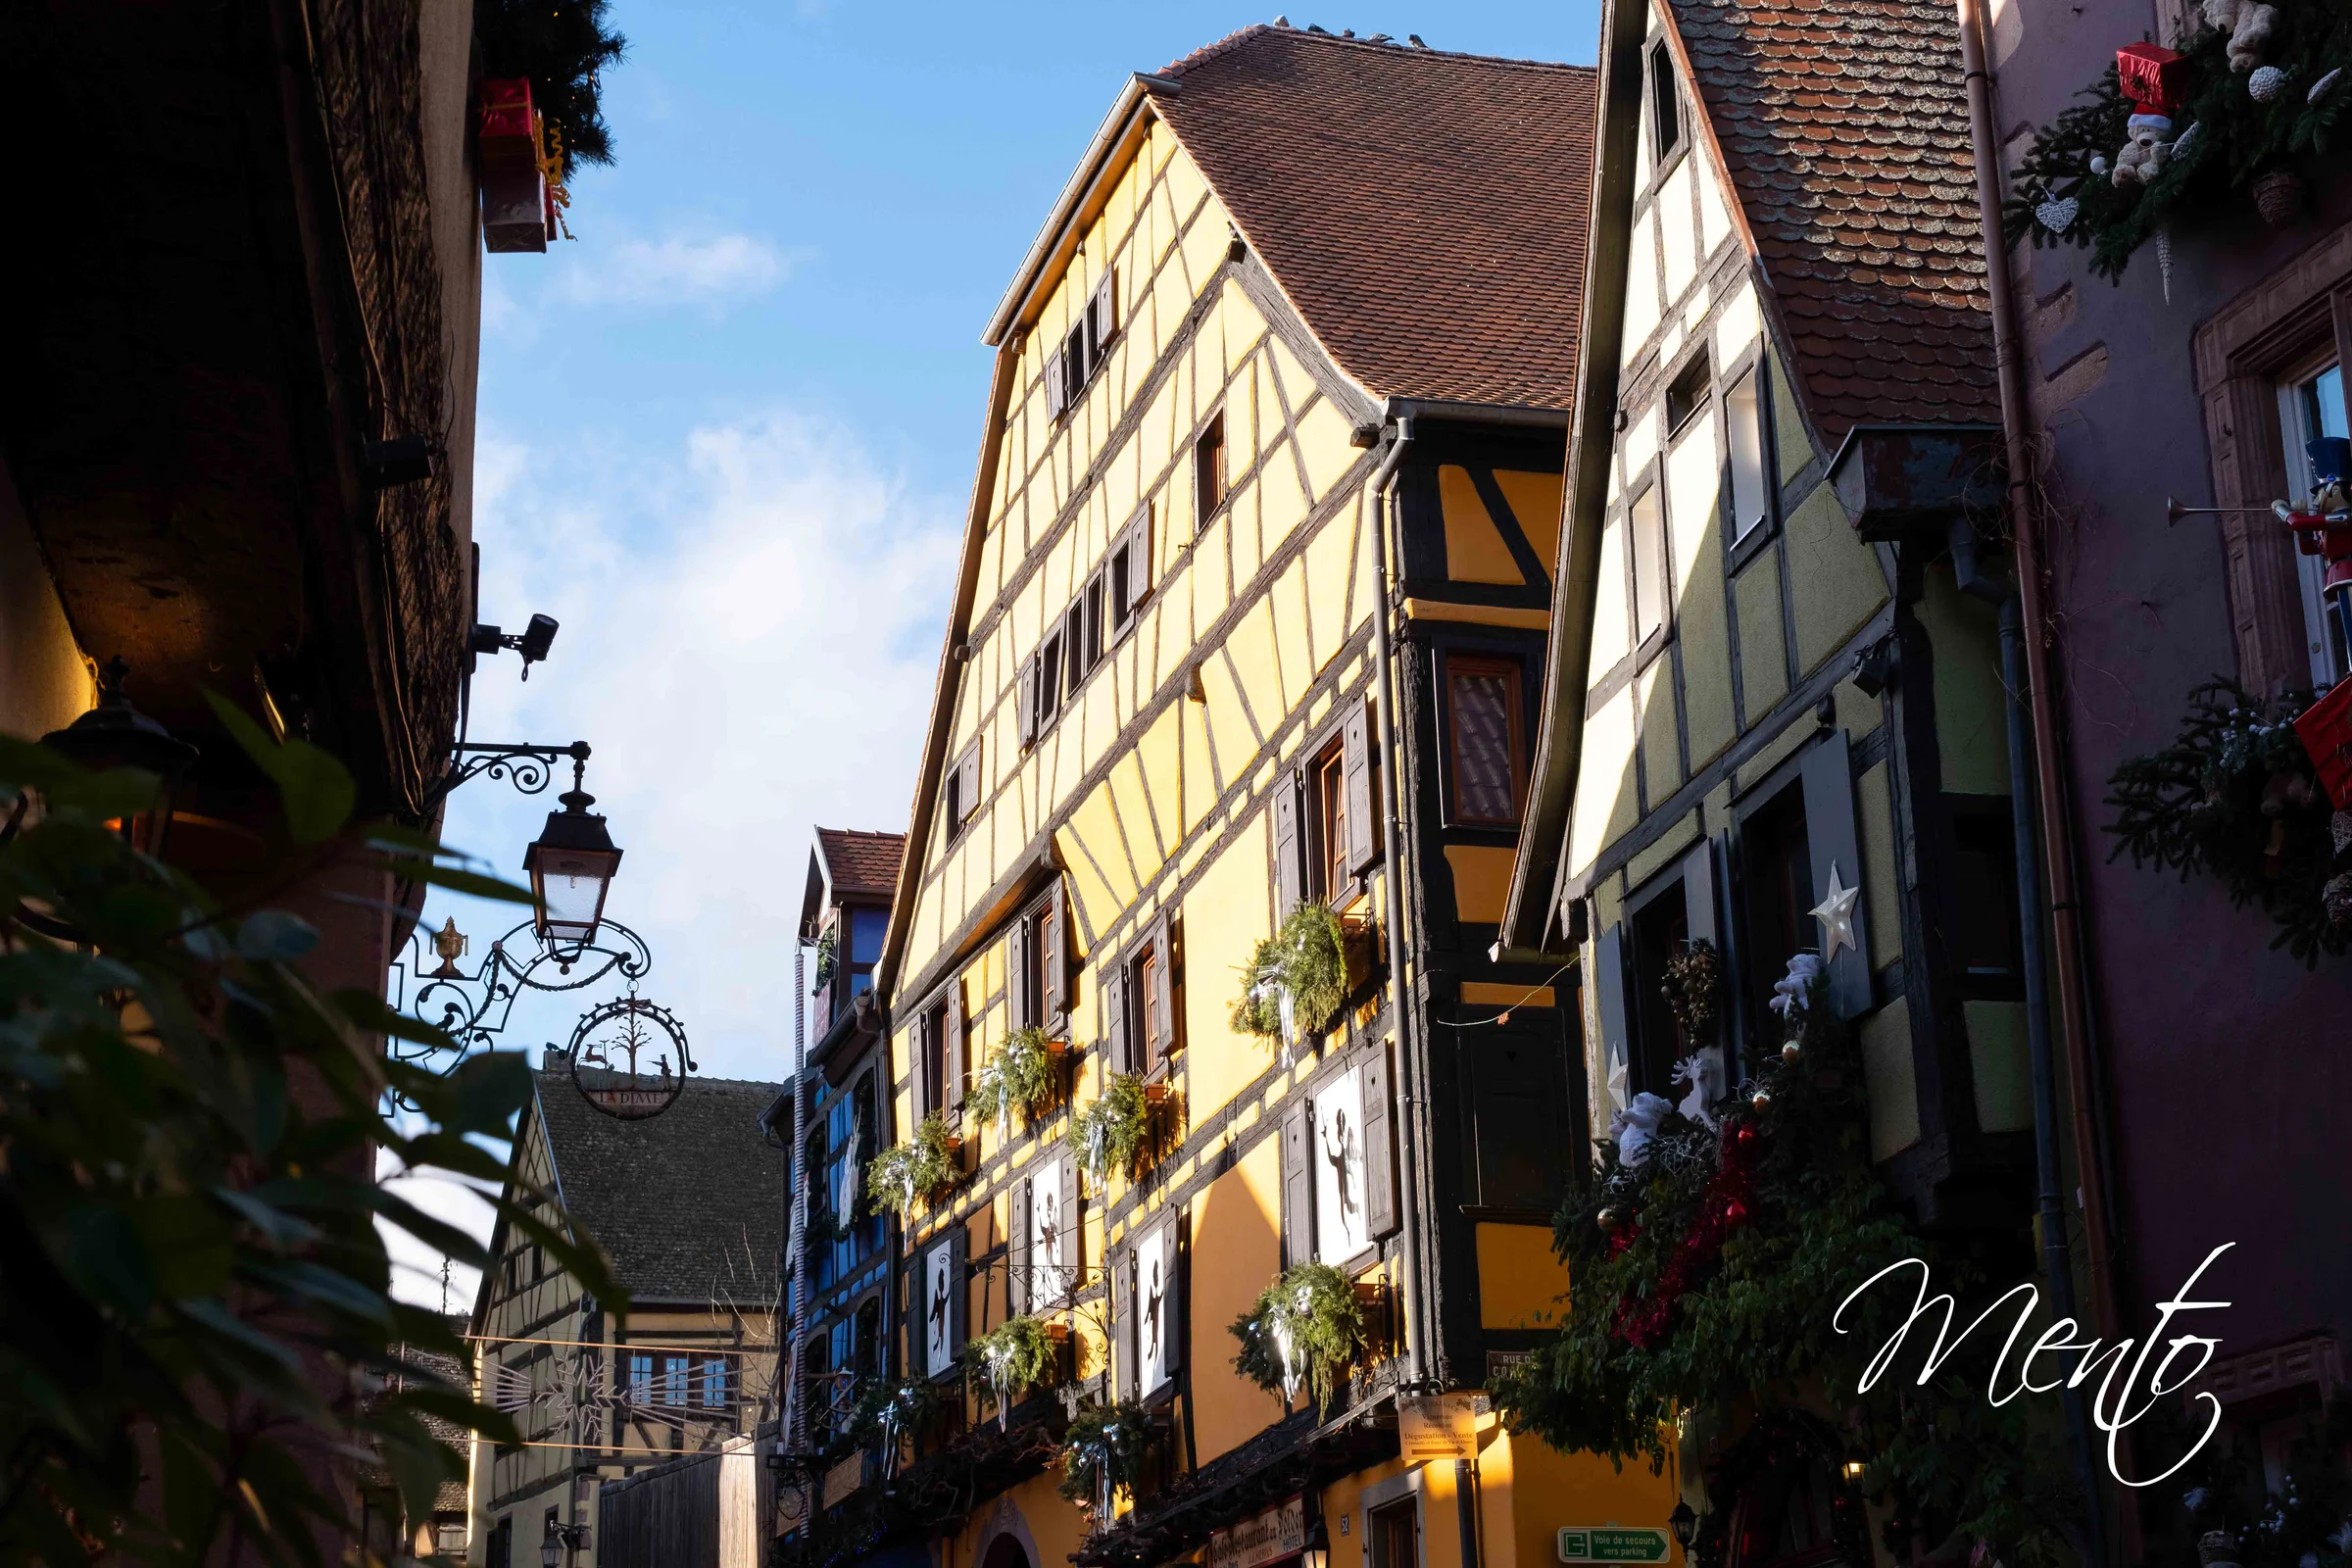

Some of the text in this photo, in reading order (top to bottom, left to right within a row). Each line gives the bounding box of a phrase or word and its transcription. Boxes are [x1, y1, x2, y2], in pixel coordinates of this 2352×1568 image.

[599, 1093, 616, 1102] LA
[1502, 1354, 1521, 1364] RUE
[1404, 1432, 1446, 1441] Dégustation
[1593, 1535, 1656, 1545] Voie de secours
[1621, 1547, 1647, 1558] parking
